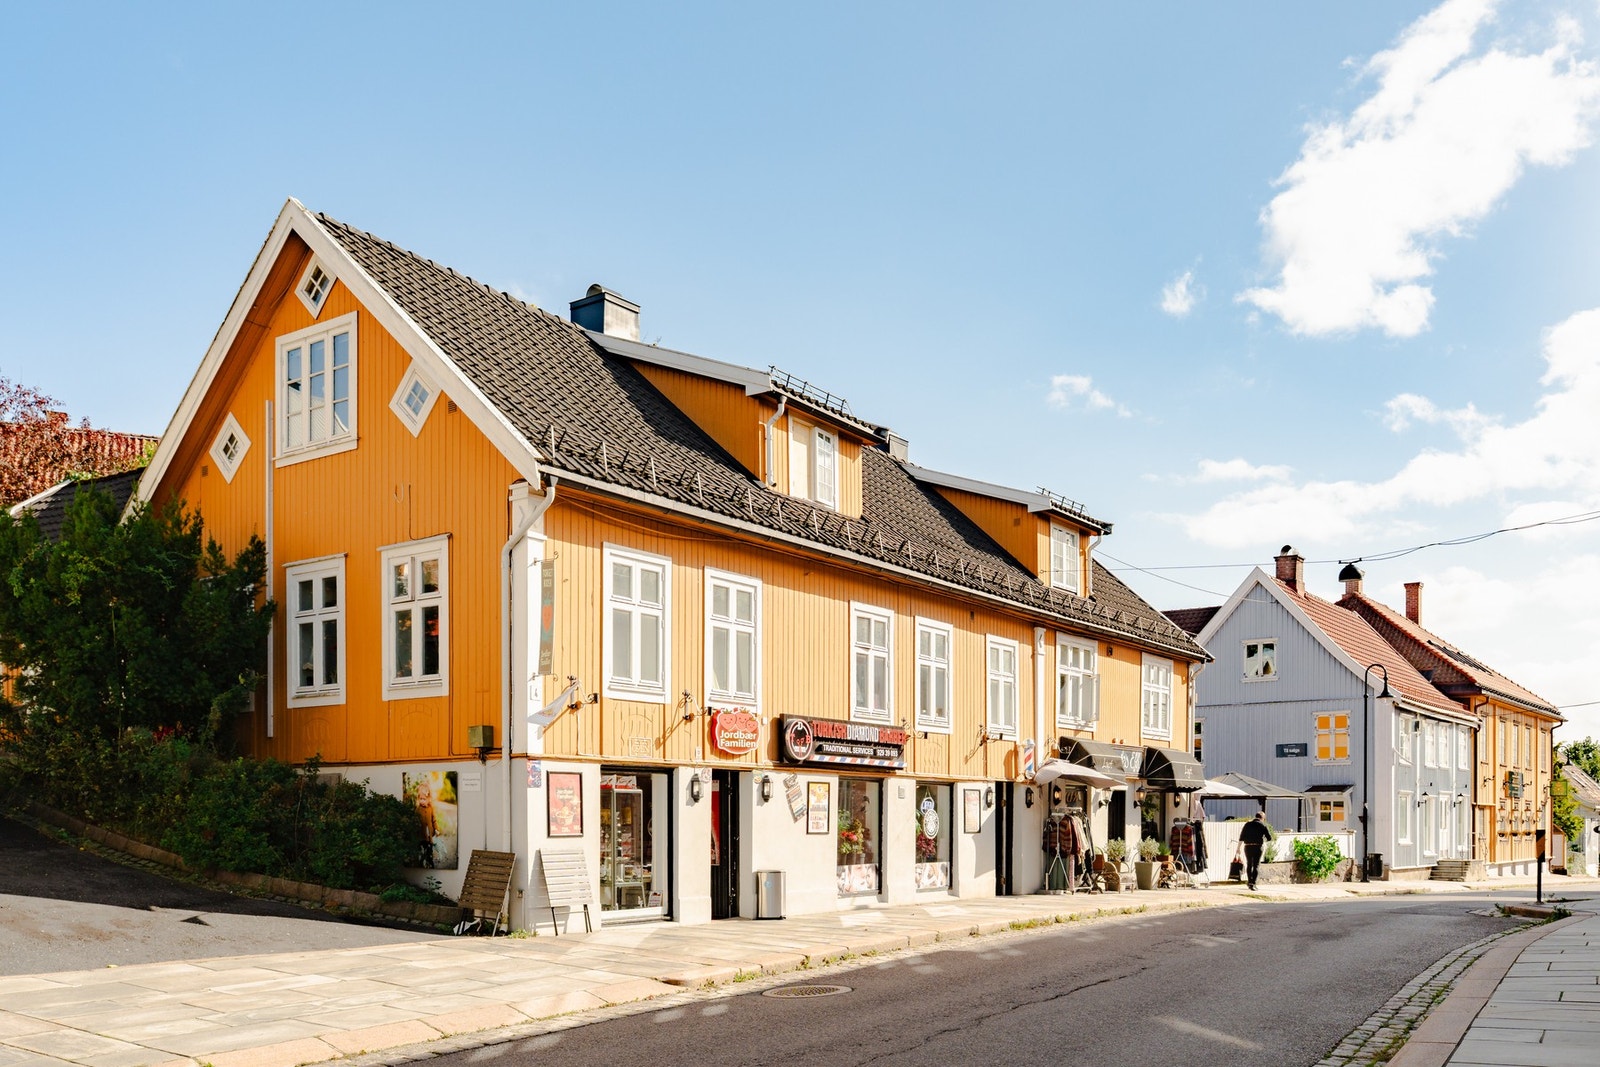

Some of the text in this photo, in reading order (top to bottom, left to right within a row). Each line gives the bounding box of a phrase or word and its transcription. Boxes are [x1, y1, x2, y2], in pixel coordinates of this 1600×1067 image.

[720, 730, 757, 739] Jordbær
[813, 720, 907, 745] TURKISH DIAMOND BARBER
[720, 738, 756, 748] Familien
[823, 744, 852, 753] TRADITIONAL
